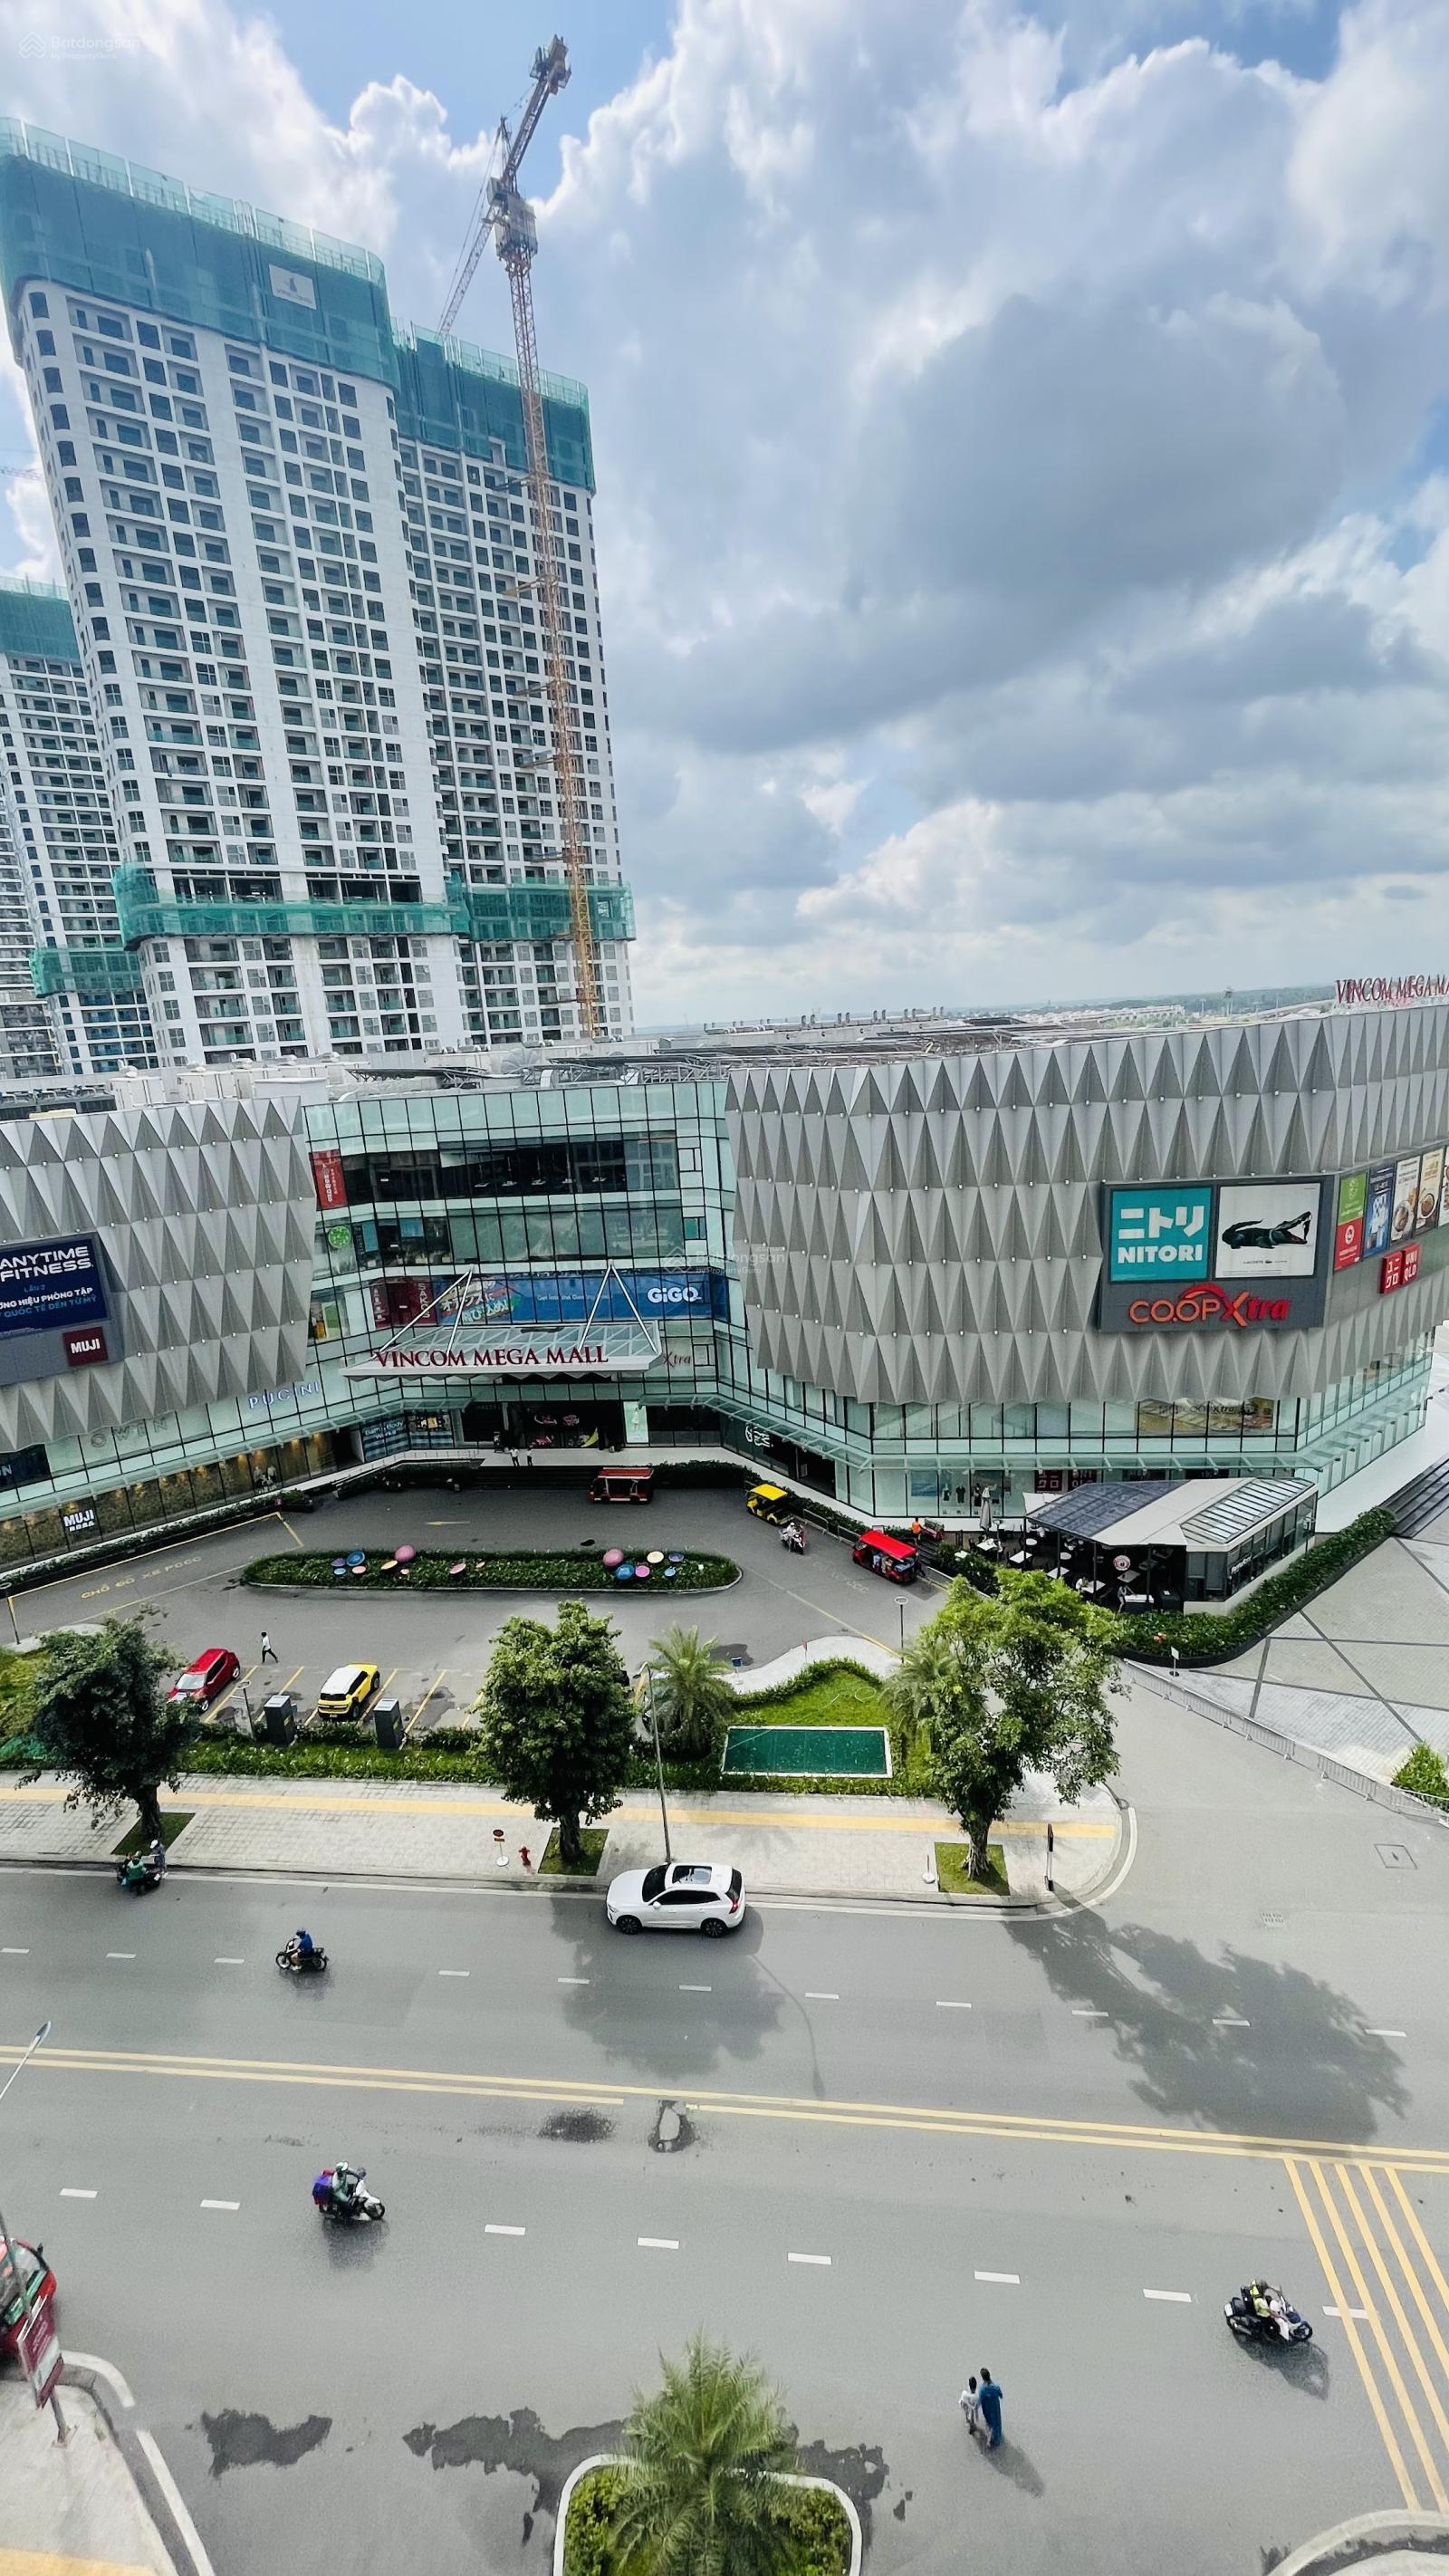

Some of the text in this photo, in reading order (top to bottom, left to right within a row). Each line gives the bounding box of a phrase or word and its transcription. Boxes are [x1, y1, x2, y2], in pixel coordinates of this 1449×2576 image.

[1335, 976, 1393, 1004] VINCOM
[1396, 975, 1432, 998] MEGA
[1118, 1206, 1204, 1240] ニトリ
[0, 1245, 90, 1269] ANYTIME
[1118, 1245, 1204, 1264] NITORI
[0, 1257, 91, 1283] FITNESS
[647, 1286, 700, 1304] GiGO
[70, 1338, 101, 1354] MUJI
[375, 1345, 609, 1368] VINCOM MEGA MALL
[91, 1417, 169, 1448] OWEN
[63, 1509, 95, 1527] MUJI
